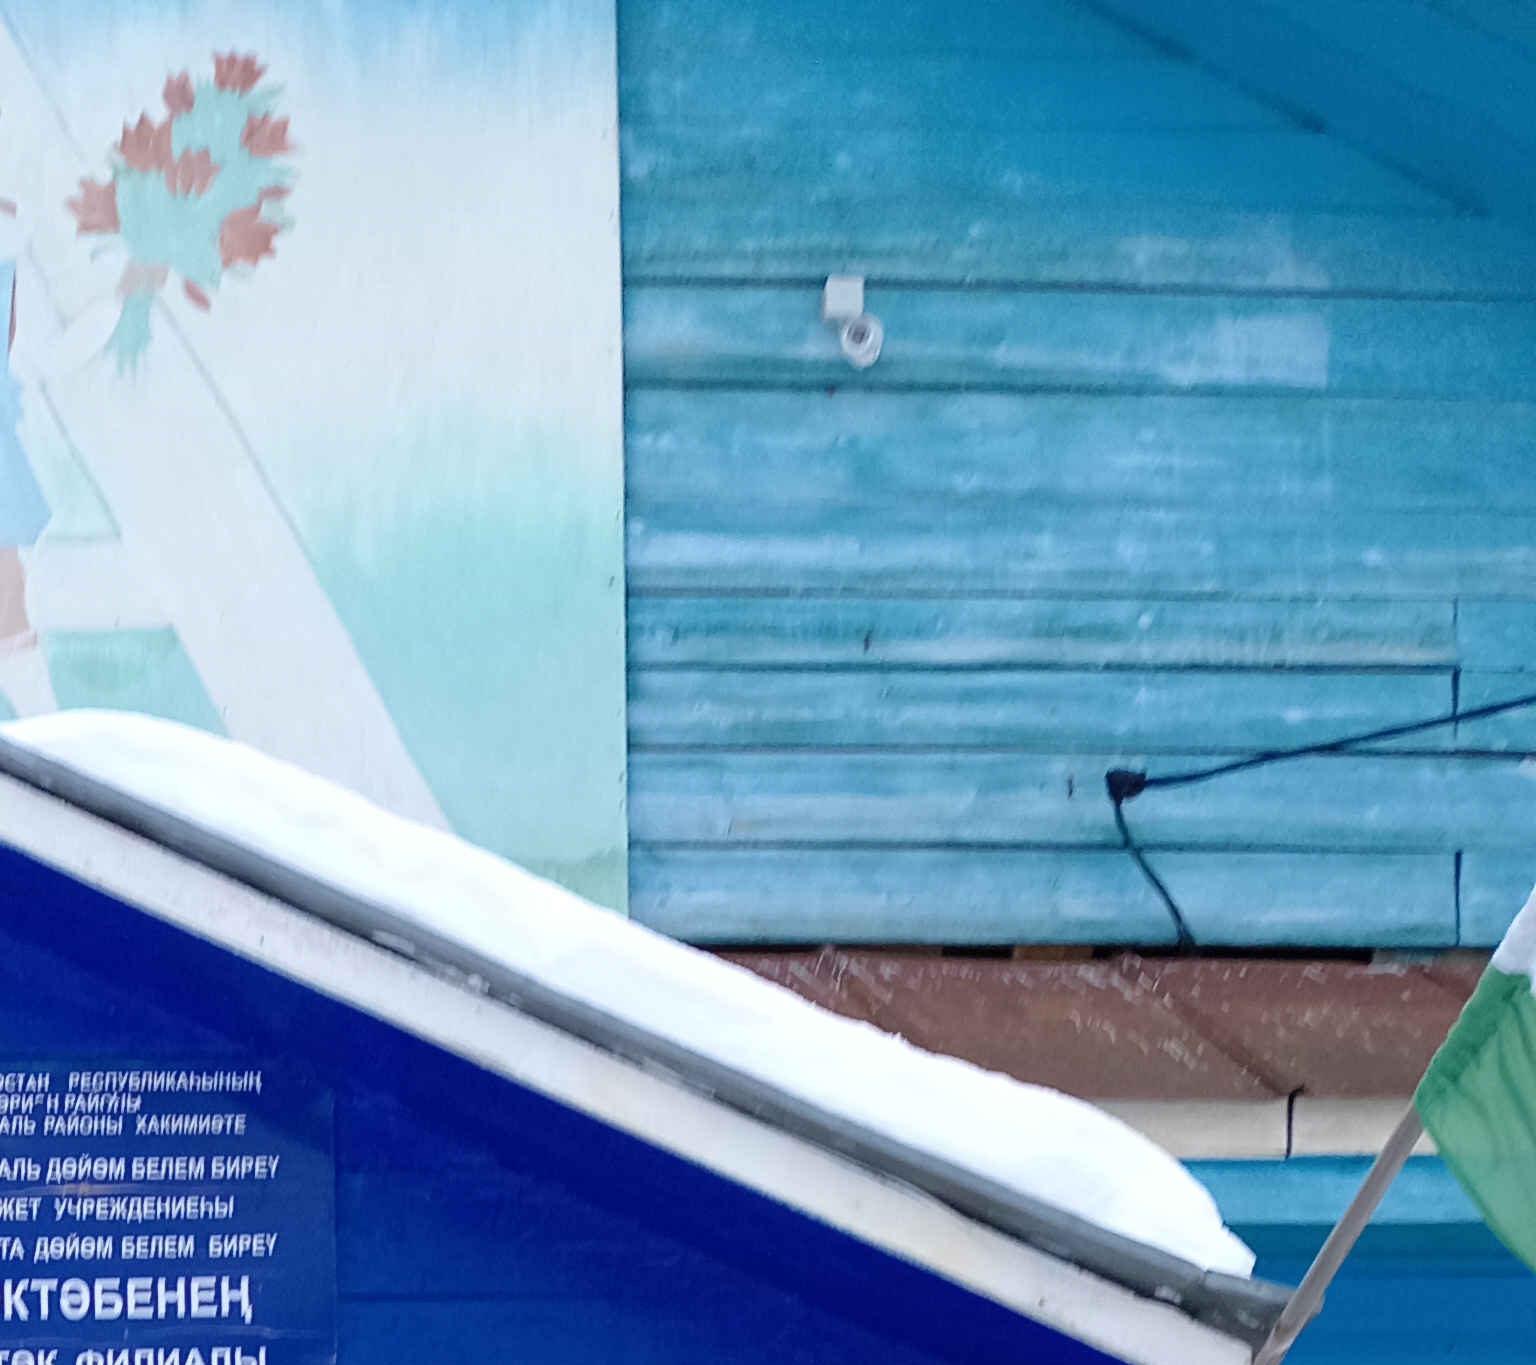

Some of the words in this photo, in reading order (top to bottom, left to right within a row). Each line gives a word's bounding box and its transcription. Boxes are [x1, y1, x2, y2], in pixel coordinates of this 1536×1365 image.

[44, 1112, 124, 1135] РАЙОНЫ
[46, 1154, 127, 1185] ДӨЙӨМ
[132, 1157, 204, 1180] БЕЛЕМ
[55, 1195, 234, 1223] УЧРЕЖДЕНИЕҺЫ
[34, 1234, 113, 1263] ДӨЙӨМ
[122, 1235, 194, 1259] БЕЛЕМ
